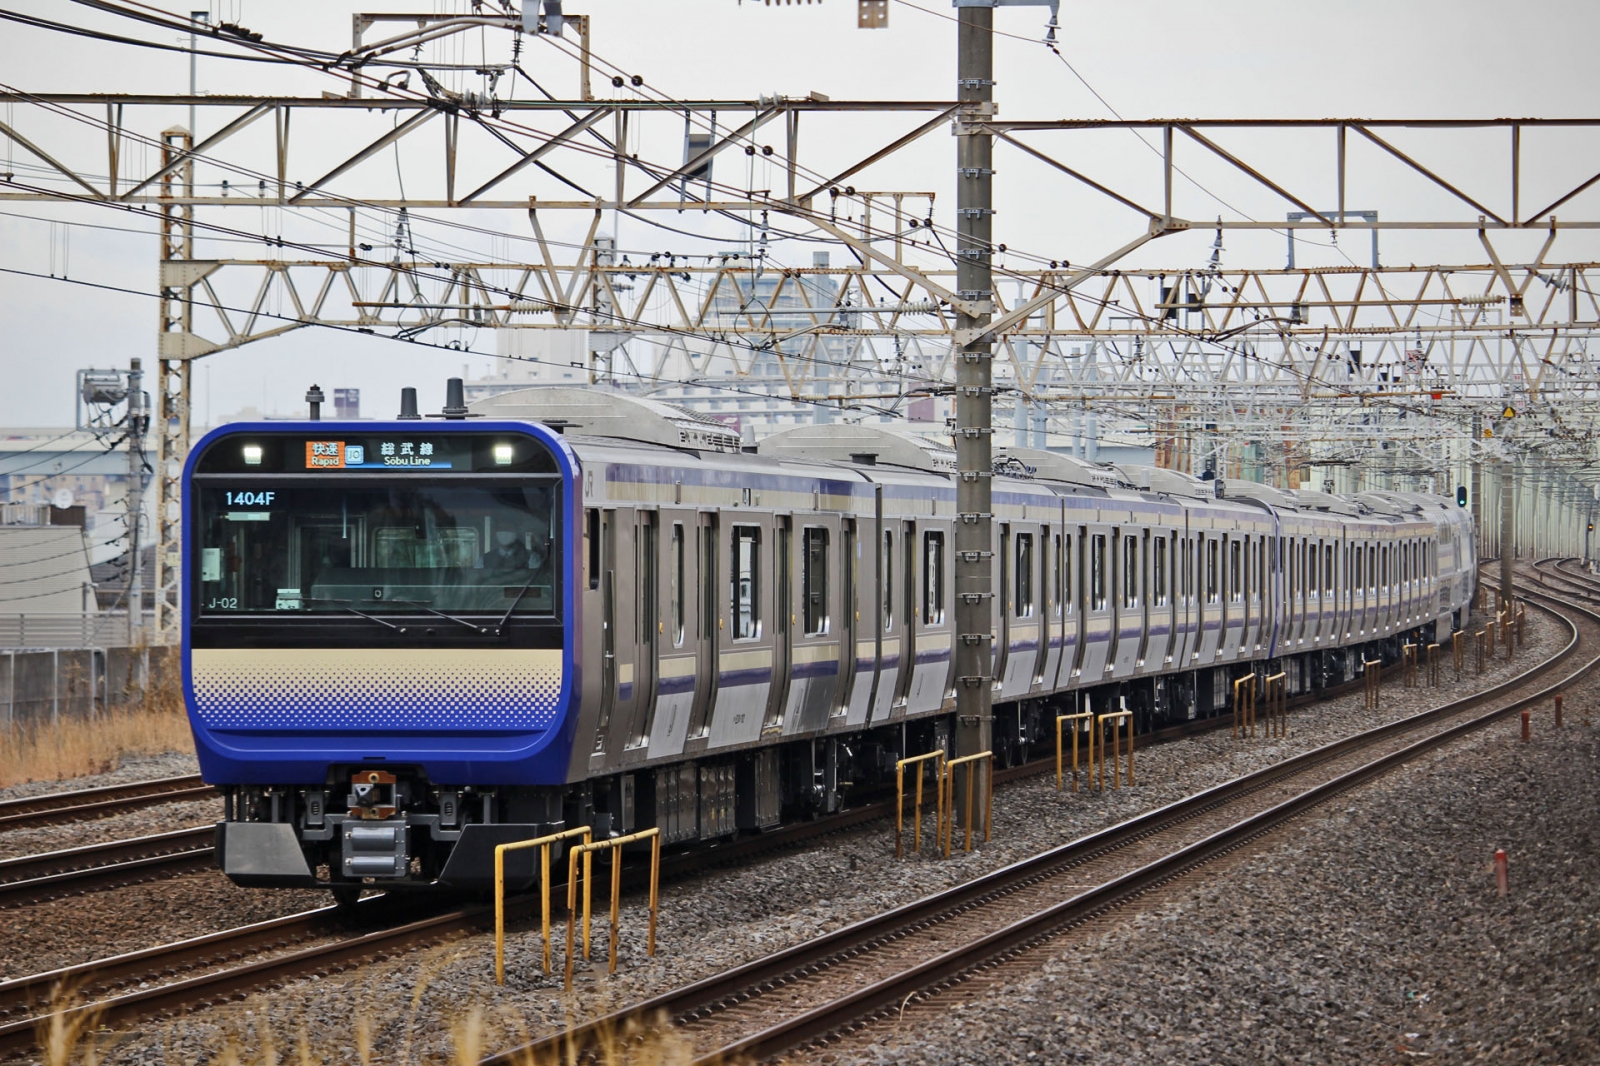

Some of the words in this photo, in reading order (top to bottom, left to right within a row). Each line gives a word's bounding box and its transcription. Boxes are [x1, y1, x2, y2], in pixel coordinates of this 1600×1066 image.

[312, 442, 338, 456] 快速
[381, 442, 433, 456] 総武線
[311, 457, 340, 467] Rapid
[384, 456, 408, 466] Sōbu
[409, 456, 431, 466] Line
[225, 492, 275, 506] 1404F
[209, 597, 237, 609] J-02
